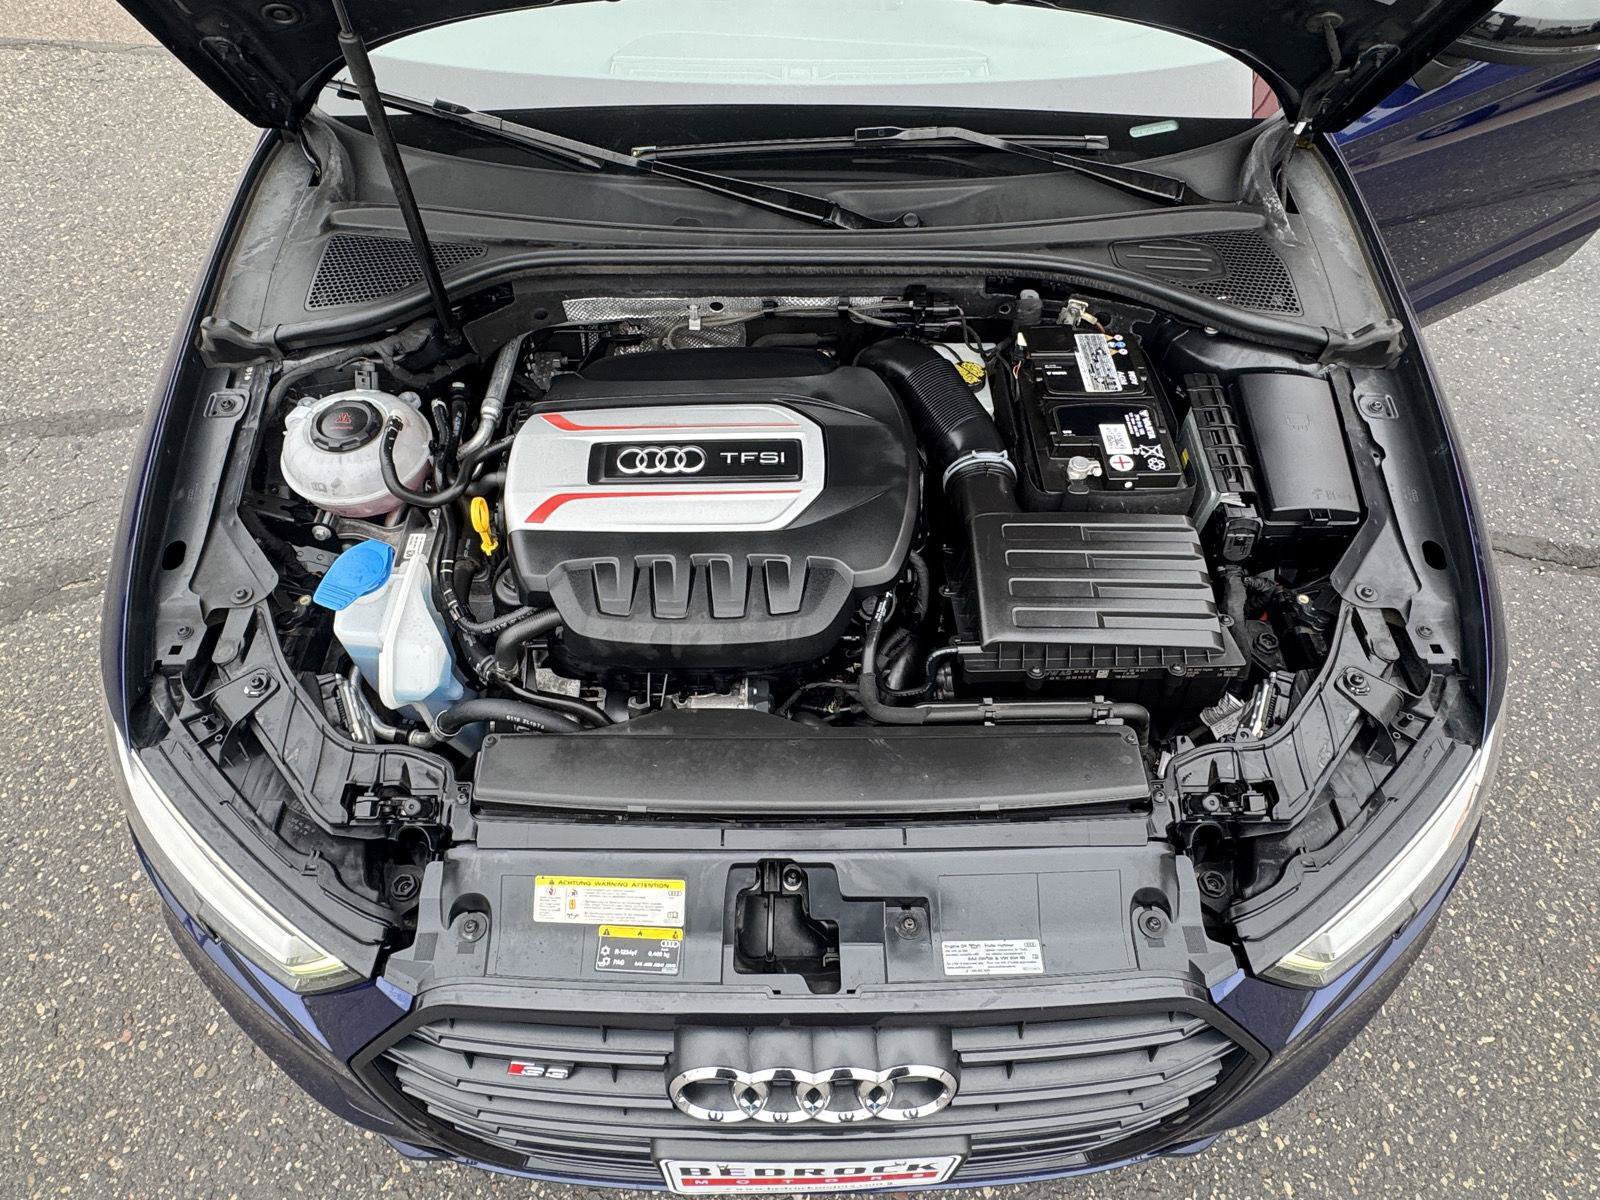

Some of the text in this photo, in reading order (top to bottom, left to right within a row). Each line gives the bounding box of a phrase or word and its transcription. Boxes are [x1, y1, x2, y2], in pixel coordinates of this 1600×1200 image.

[720, 451, 786, 465] TFSI
[678, 1162, 938, 1177] BEDROCK
[694, 1173, 927, 1185] MOTORS
